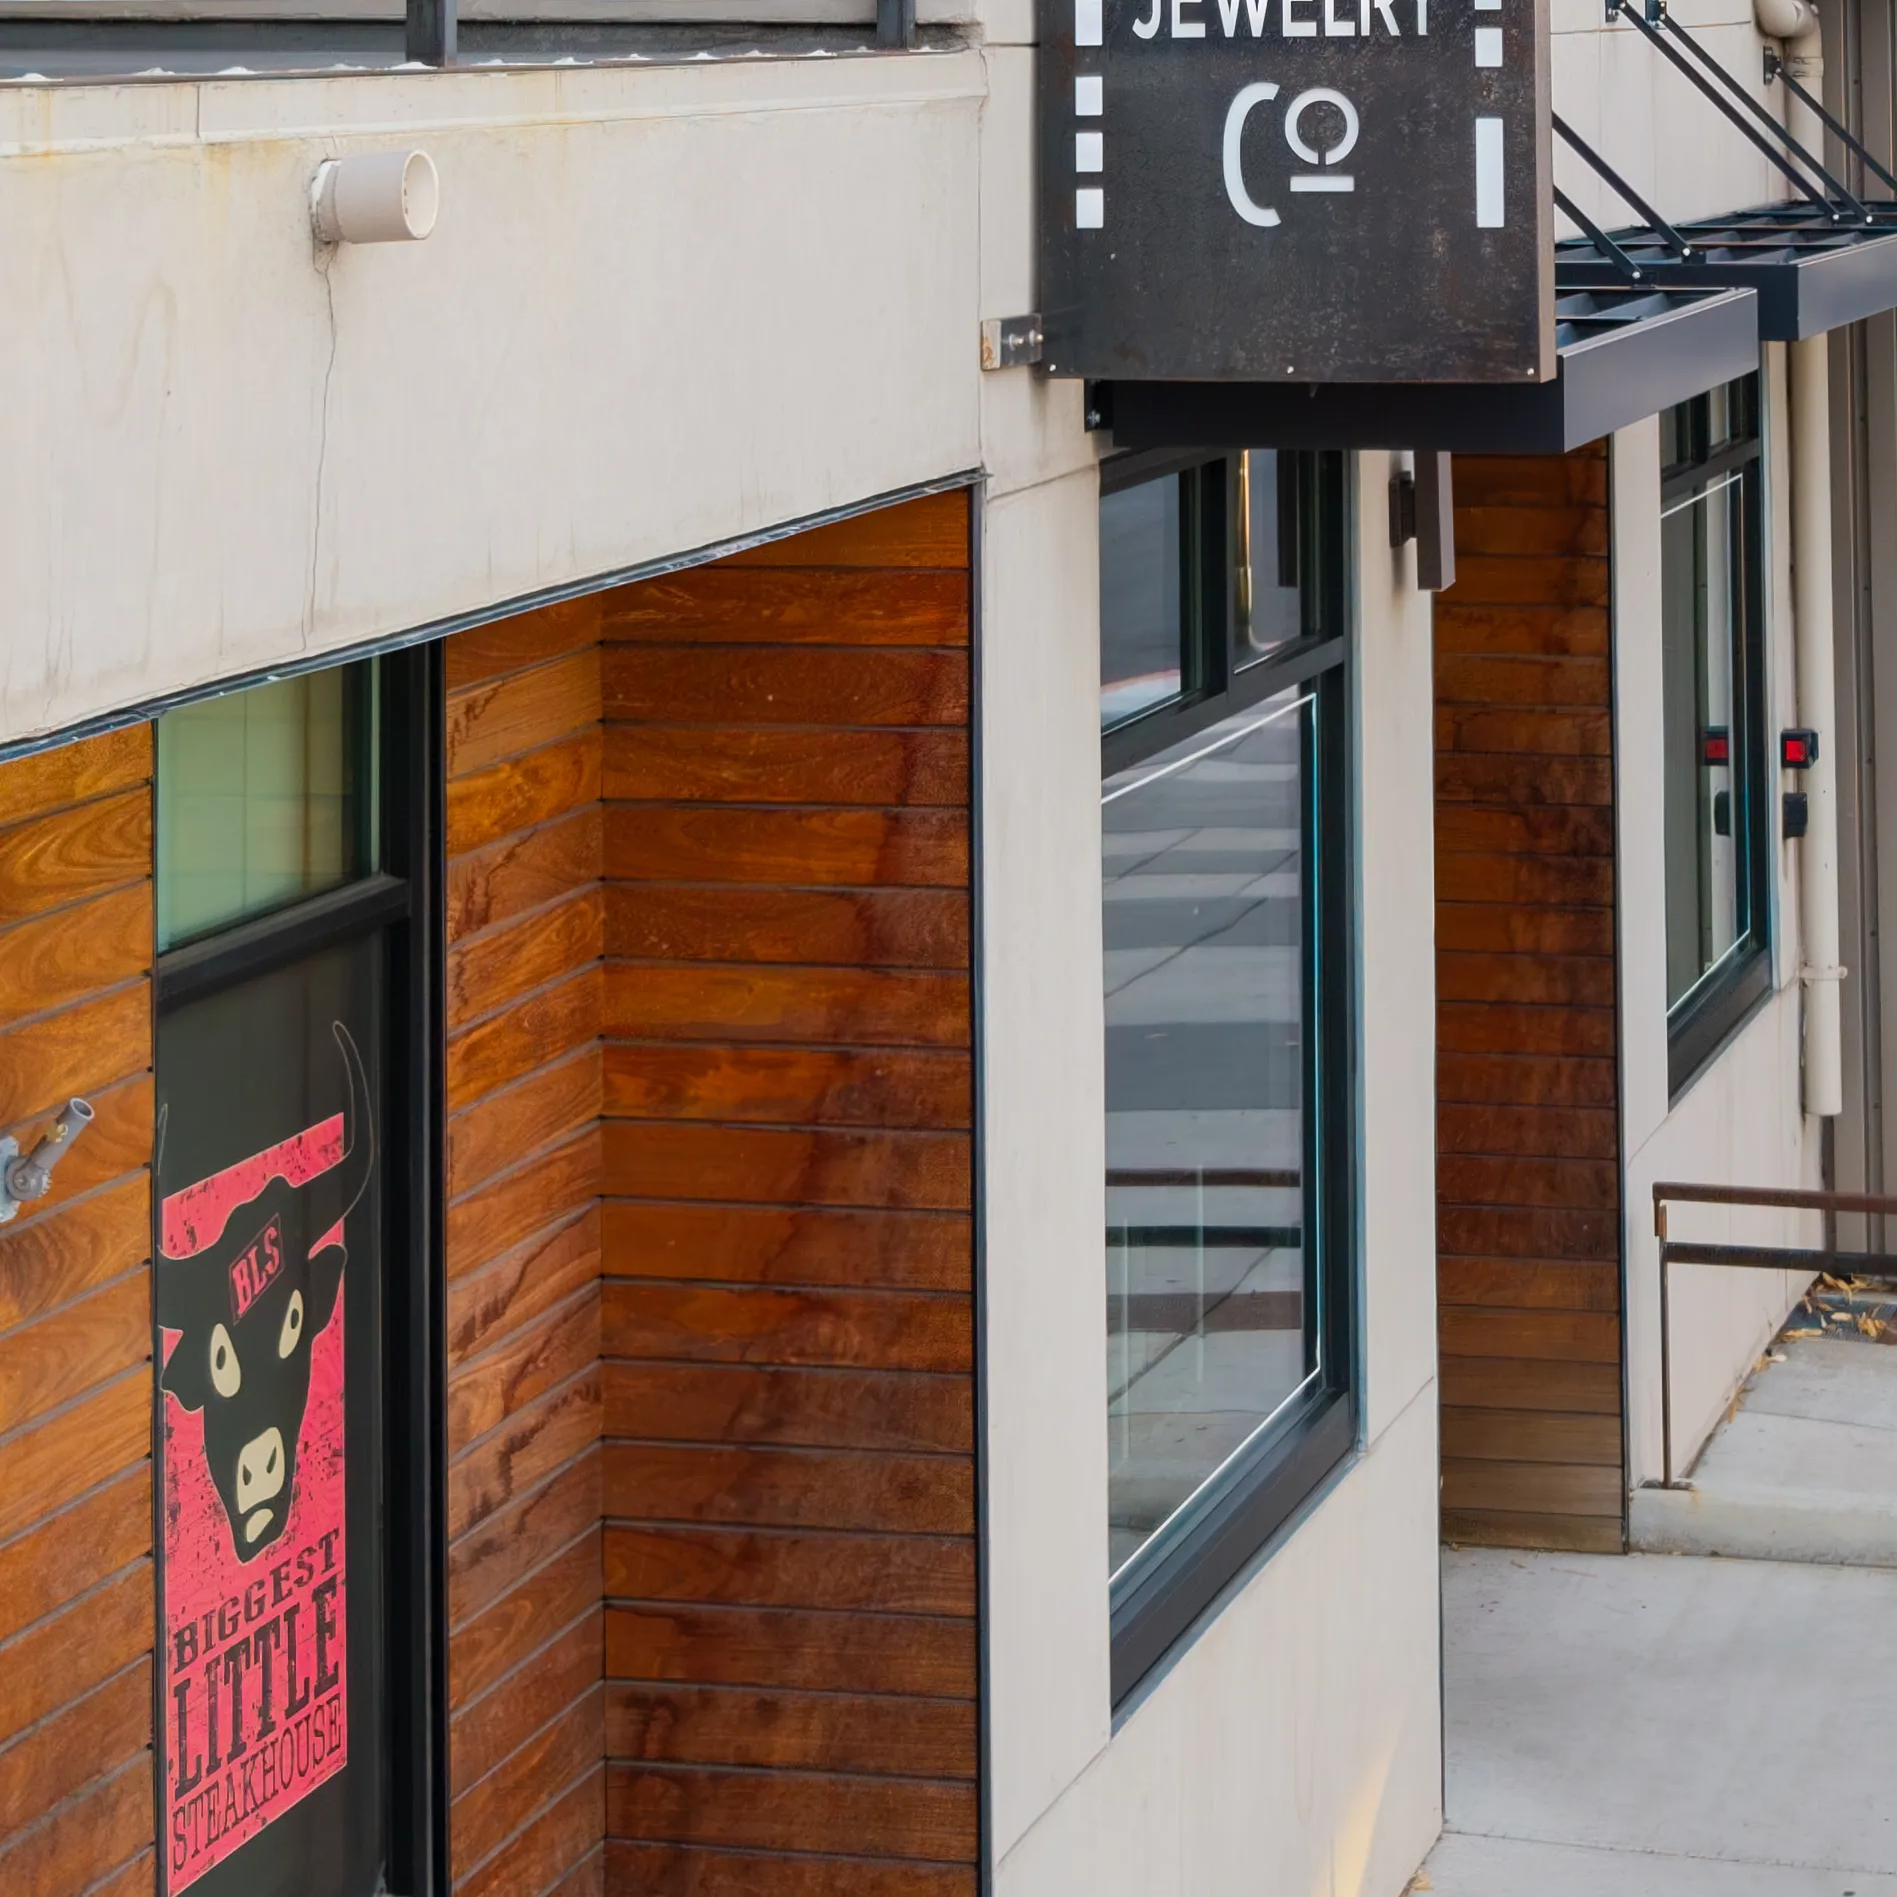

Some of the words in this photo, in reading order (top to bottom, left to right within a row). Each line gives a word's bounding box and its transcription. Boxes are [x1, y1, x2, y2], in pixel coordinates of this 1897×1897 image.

[173, 1528, 340, 1675] BIGGEST
[174, 1579, 340, 1801] LITTLE
[173, 1693, 342, 1875] STEAKHOUSE
